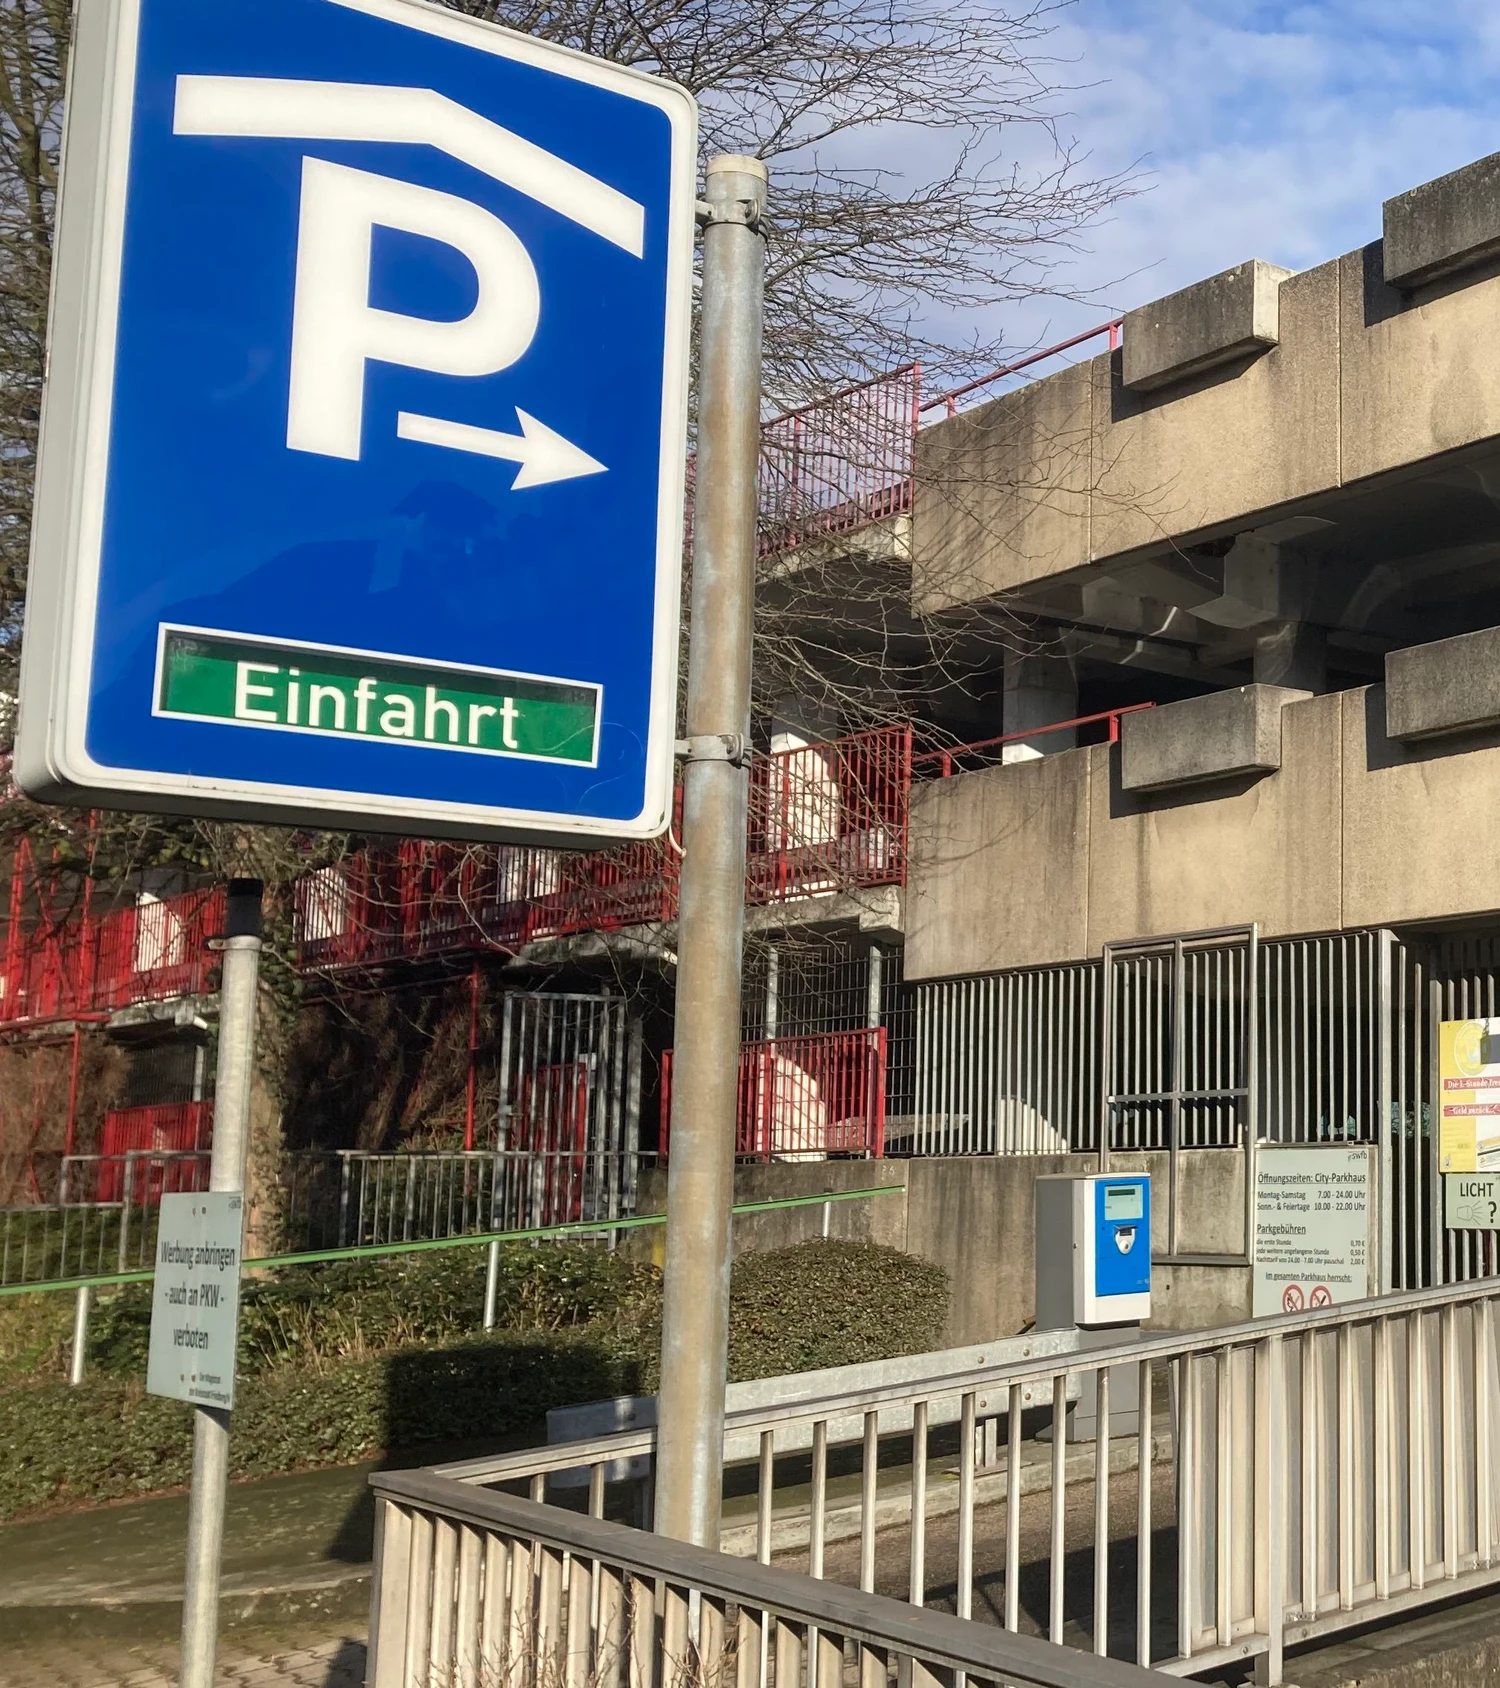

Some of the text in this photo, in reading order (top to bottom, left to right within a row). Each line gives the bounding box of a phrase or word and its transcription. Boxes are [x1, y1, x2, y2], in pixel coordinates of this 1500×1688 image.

[286, 155, 541, 461] P
[234, 661, 520, 749] Einfahrt
[1258, 1171, 1366, 1185] Öffnungszeiten: City-Parkhaus
[1257, 1191, 1306, 1200] Montag-Samstag
[1318, 1190, 1331, 1199] 7.00
[1336, 1190, 1353, 1199] 24.00
[1354, 1190, 1366, 1199] Uhr
[1460, 1182, 1494, 1197] LICHT
[1276, 1202, 1282, 1211] &
[1283, 1202, 1310, 1212] Feiertage
[1314, 1202, 1331, 1211] 10.00
[1336, 1202, 1353, 1211] 22.00
[1354, 1202, 1366, 1211] Uhr
[1487, 1201, 1497, 1223] ?
[1256, 1223, 1306, 1235] Parkgebühren
[161, 1240, 235, 1271] Werbung anbringen
[1273, 1272, 1300, 1281] gesamten
[1301, 1272, 1326, 1281] Parkhaus
[169, 1281, 187, 1305] auch
[188, 1287, 198, 1306] an
[200, 1283, 220, 1308] PKW
[173, 1323, 209, 1349] verboten
